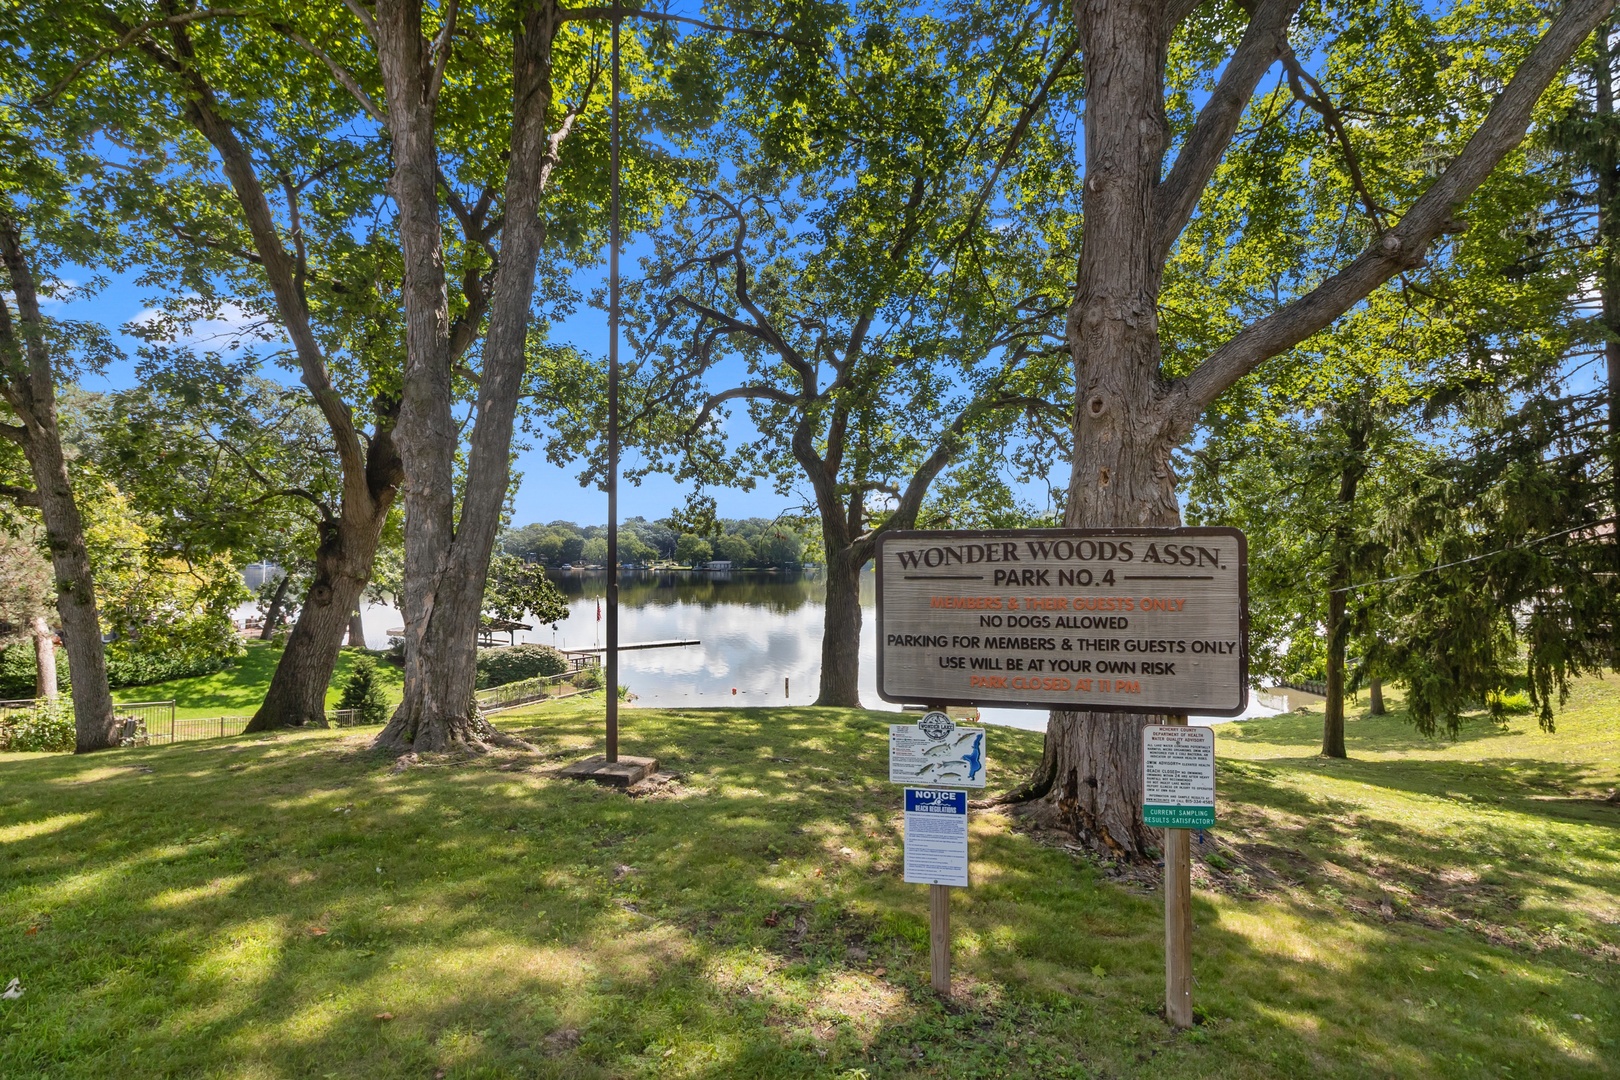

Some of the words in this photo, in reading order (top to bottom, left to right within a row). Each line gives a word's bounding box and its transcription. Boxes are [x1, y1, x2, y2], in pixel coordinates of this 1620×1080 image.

[896, 542, 1020, 570] WONDER
[1026, 540, 1134, 562] WOODS
[1142, 543, 1226, 570] ASSN.
[994, 569, 1050, 586] PARK
[930, 596, 1002, 610] MEMBERS
[1009, 597, 1018, 610] &
[1024, 597, 1067, 610] THEIR
[1073, 598, 1134, 611] GUESTS
[1140, 598, 1185, 611] ONLY
[980, 615, 1003, 627] NO
[1007, 616, 1050, 628] DOGS
[1055, 616, 1128, 629] ALLOWED
[888, 635, 948, 648] PARKING
[952, 636, 980, 648] FOR
[984, 637, 1056, 650] MEMBERS
[1062, 638, 1072, 650] &
[1077, 638, 1120, 652] THEIR
[1124, 639, 1186, 653] GUESTS
[1192, 640, 1236, 654] ONLY
[939, 657, 966, 669] USE
[970, 657, 1002, 670] WILL
[1007, 658, 1023, 671] BE
[1027, 660, 1046, 671] AT
[1050, 660, 1092, 673] YOUR
[1096, 661, 1136, 674] OWN
[1141, 662, 1176, 675] RISK
[970, 676, 1008, 689] PARK
[1012, 677, 1071, 691] CLOSED
[1075, 679, 1093, 691] AT
[1098, 680, 1110, 692] 11
[1116, 680, 1140, 693] PM
[916, 791, 956, 800] NOTICE
